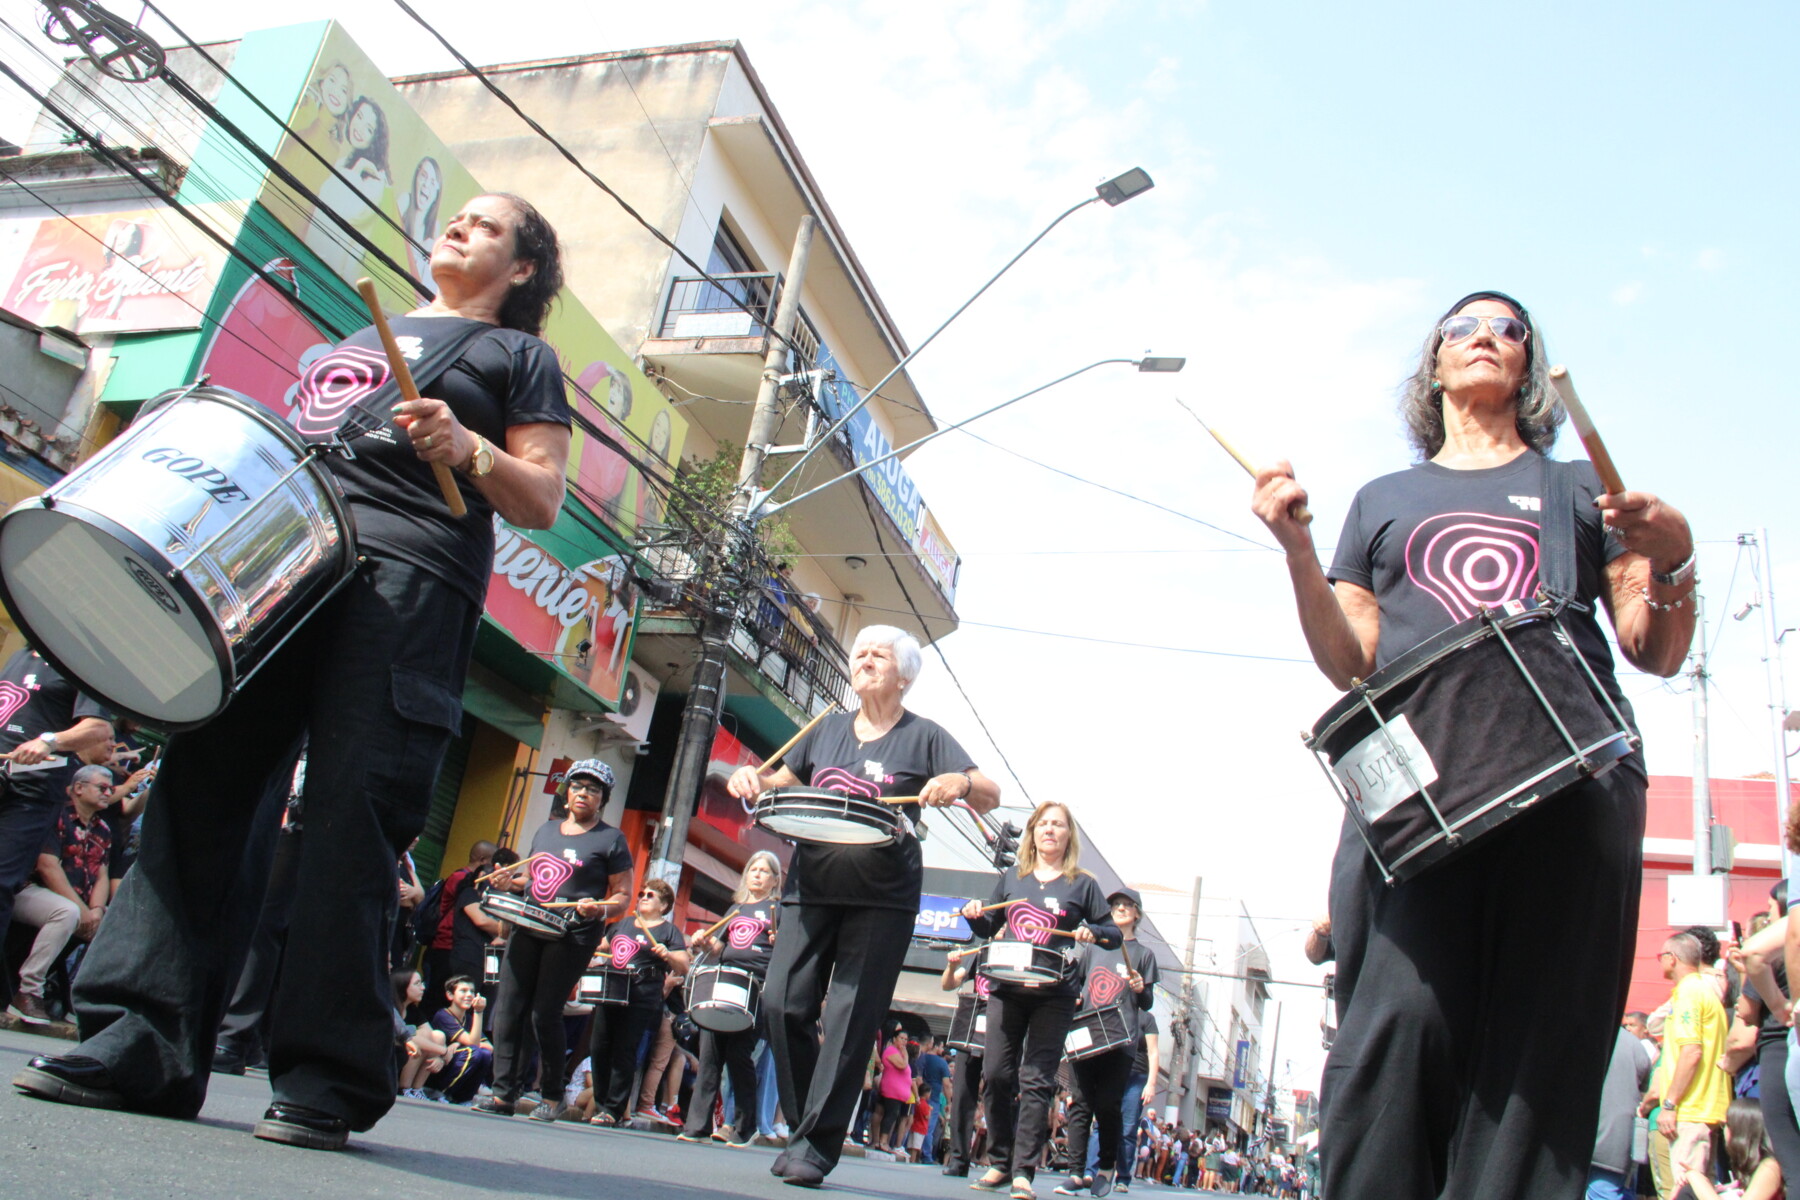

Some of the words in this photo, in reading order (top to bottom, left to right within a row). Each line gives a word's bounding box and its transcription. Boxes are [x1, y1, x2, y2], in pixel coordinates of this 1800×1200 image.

[142, 447, 251, 504] GOPE
[863, 417, 922, 522] ALUGA
[1356, 744, 1413, 793] Lyra
